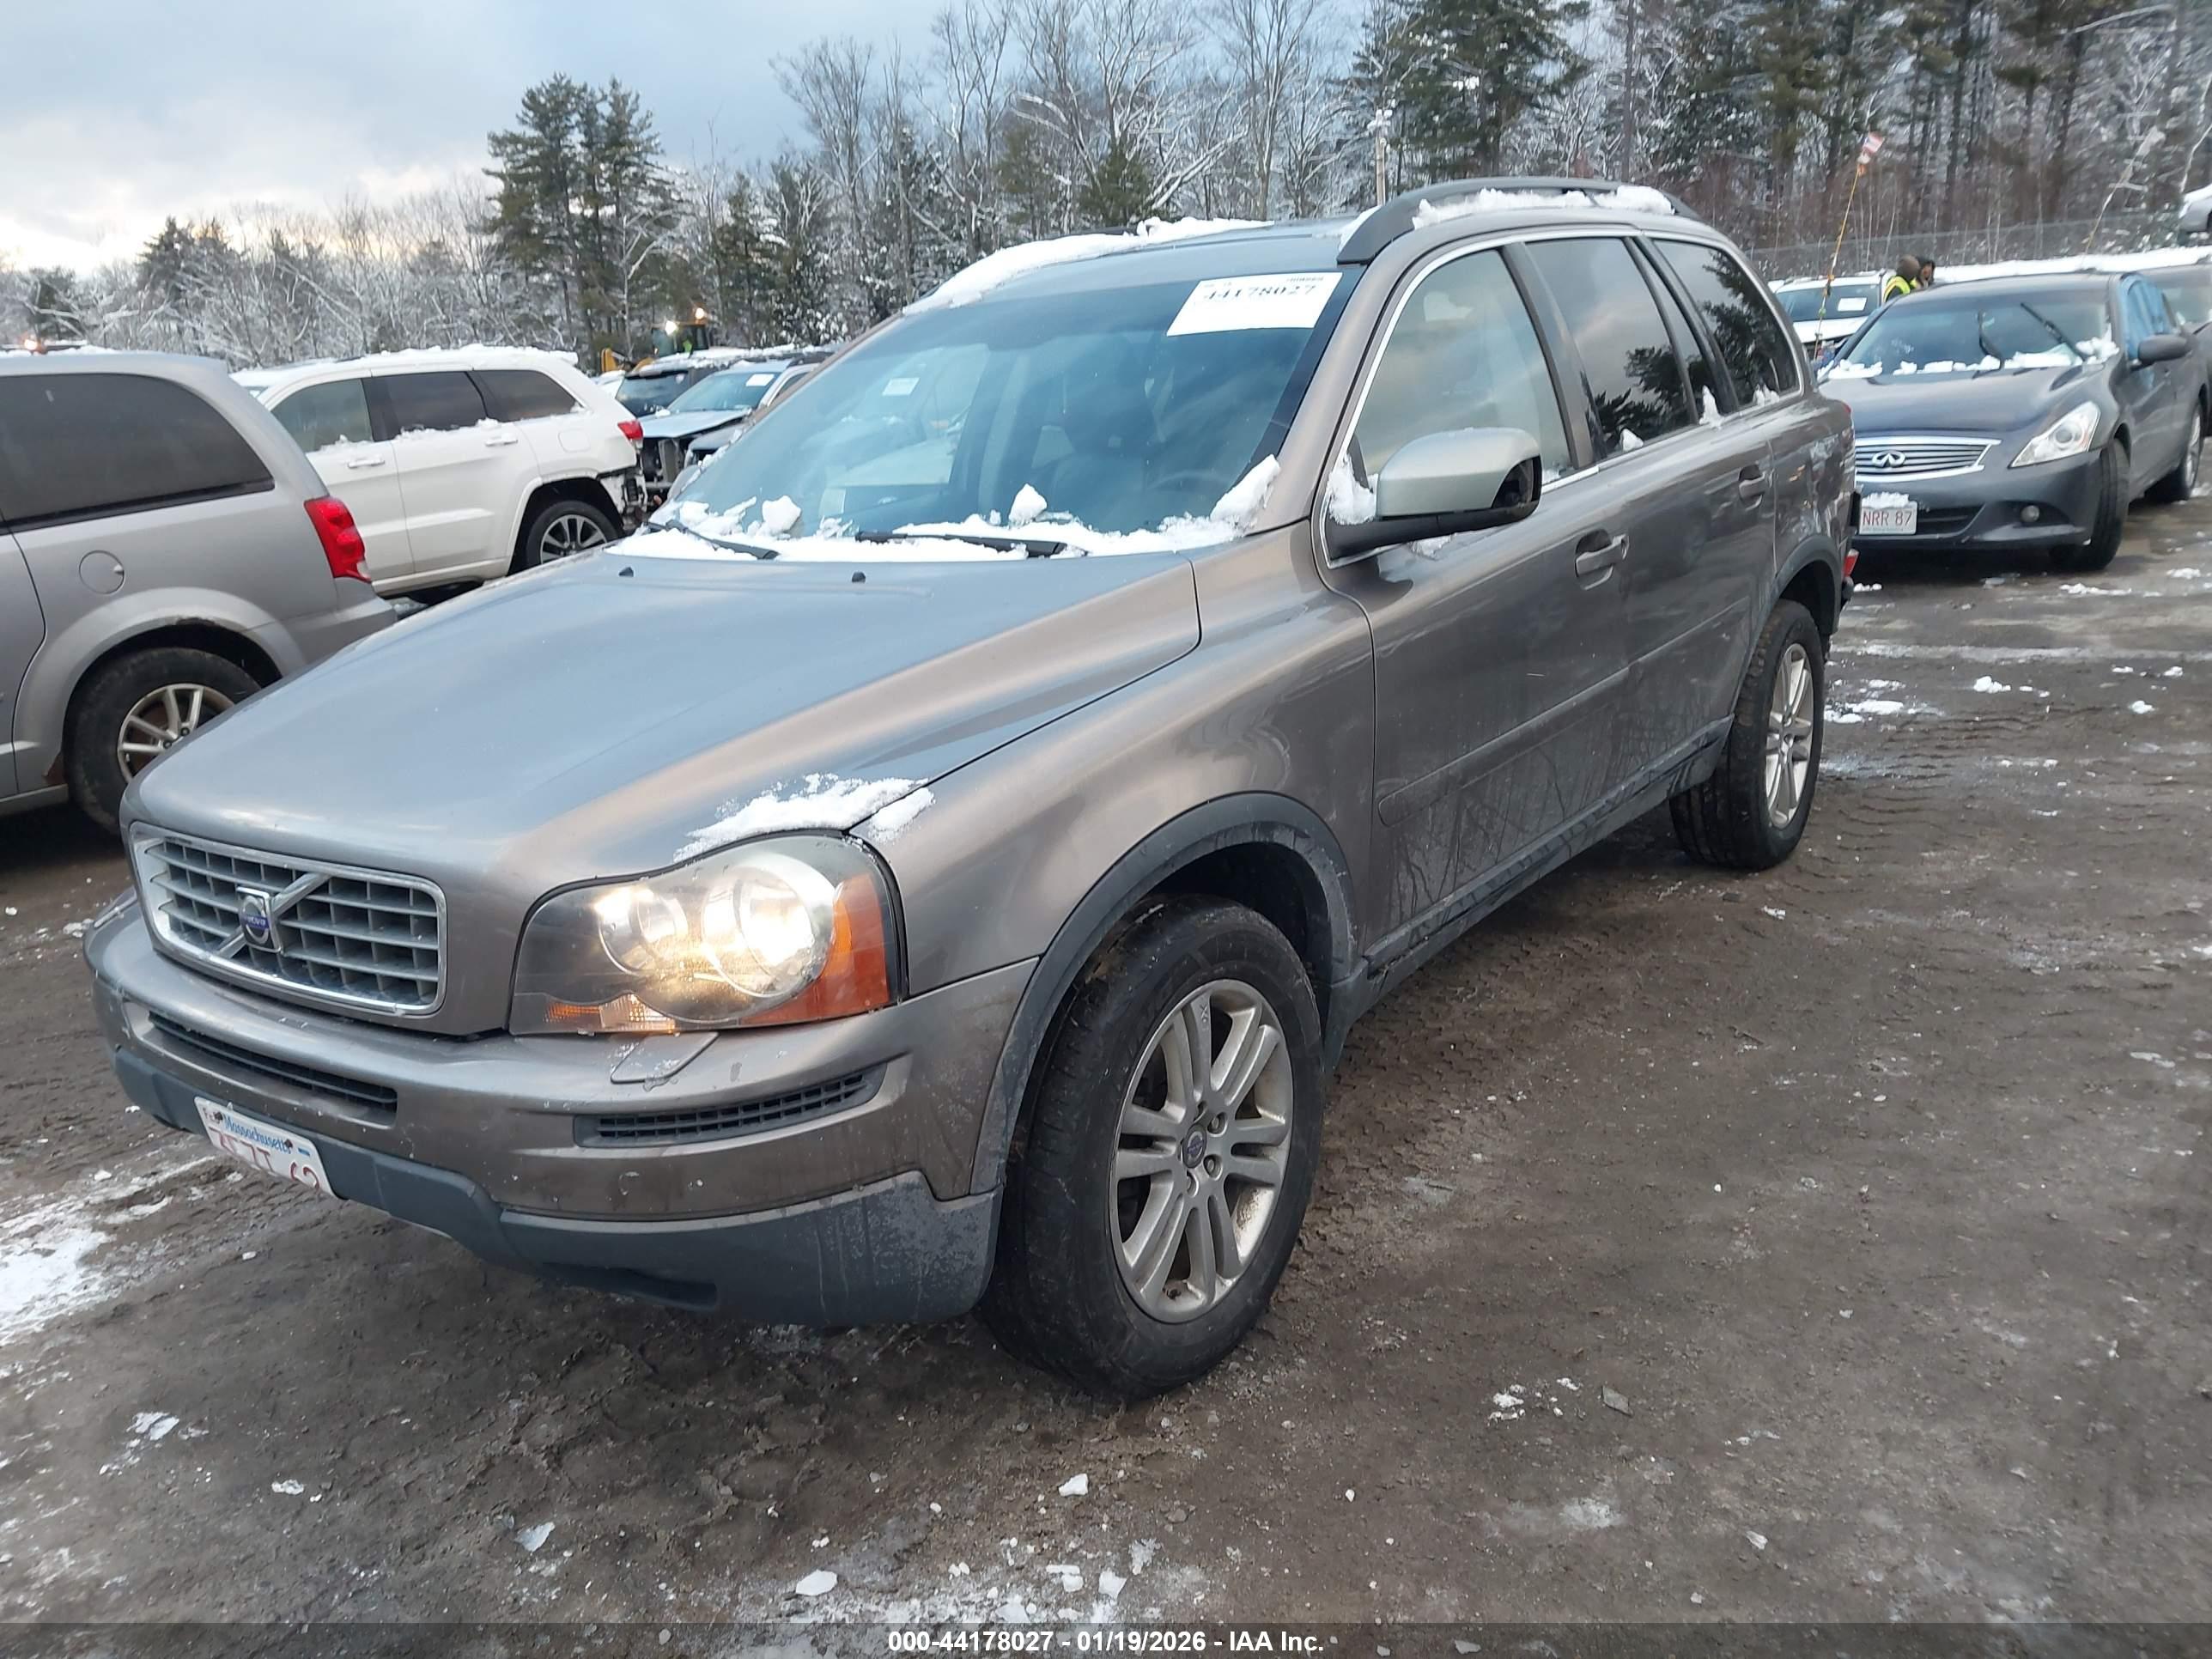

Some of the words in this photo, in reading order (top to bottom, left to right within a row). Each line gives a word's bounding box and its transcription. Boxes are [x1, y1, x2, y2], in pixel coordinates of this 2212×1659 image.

[1863, 509, 1890, 526] NRR
[1895, 509, 1912, 526] 87
[223, 1114, 293, 1155] Massachusetts
